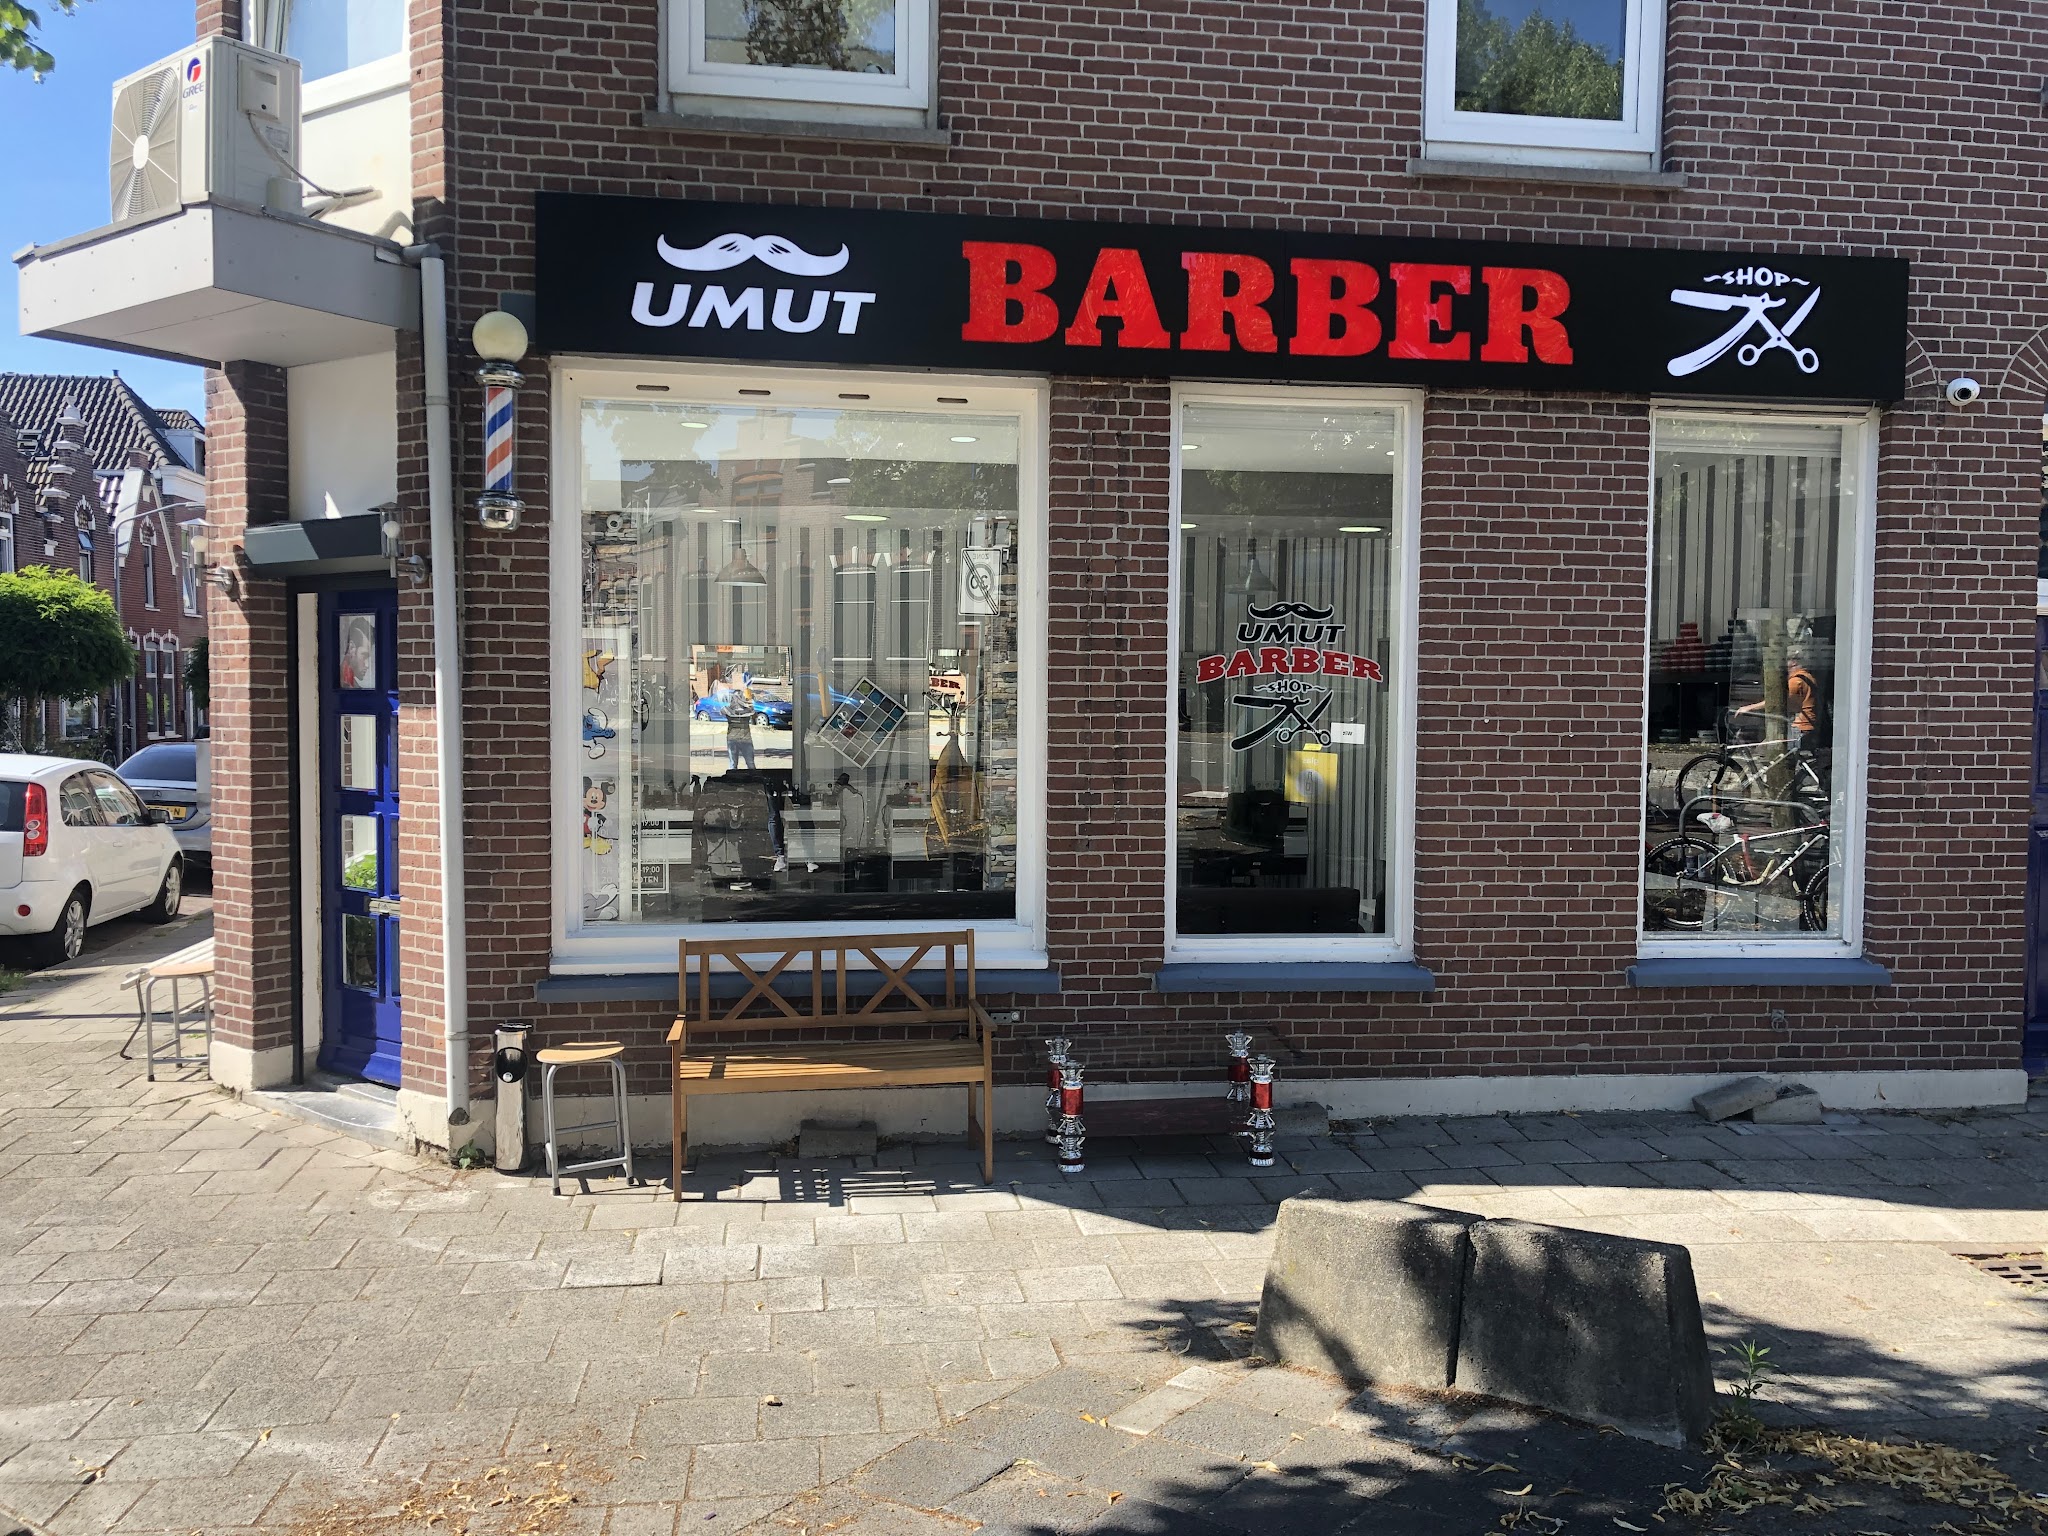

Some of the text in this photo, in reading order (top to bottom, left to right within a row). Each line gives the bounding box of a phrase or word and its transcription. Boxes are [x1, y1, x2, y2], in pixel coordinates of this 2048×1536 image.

[182, 81, 204, 99] GREE
[630, 240, 1791, 365] UMUT BARBER SHOP
[582, 547, 590, 559] 2
[1236, 622, 1346, 645] UMUT
[1196, 647, 1384, 683] BARBER
[930, 677, 961, 690] BER
[1268, 679, 1315, 693] SHOP
